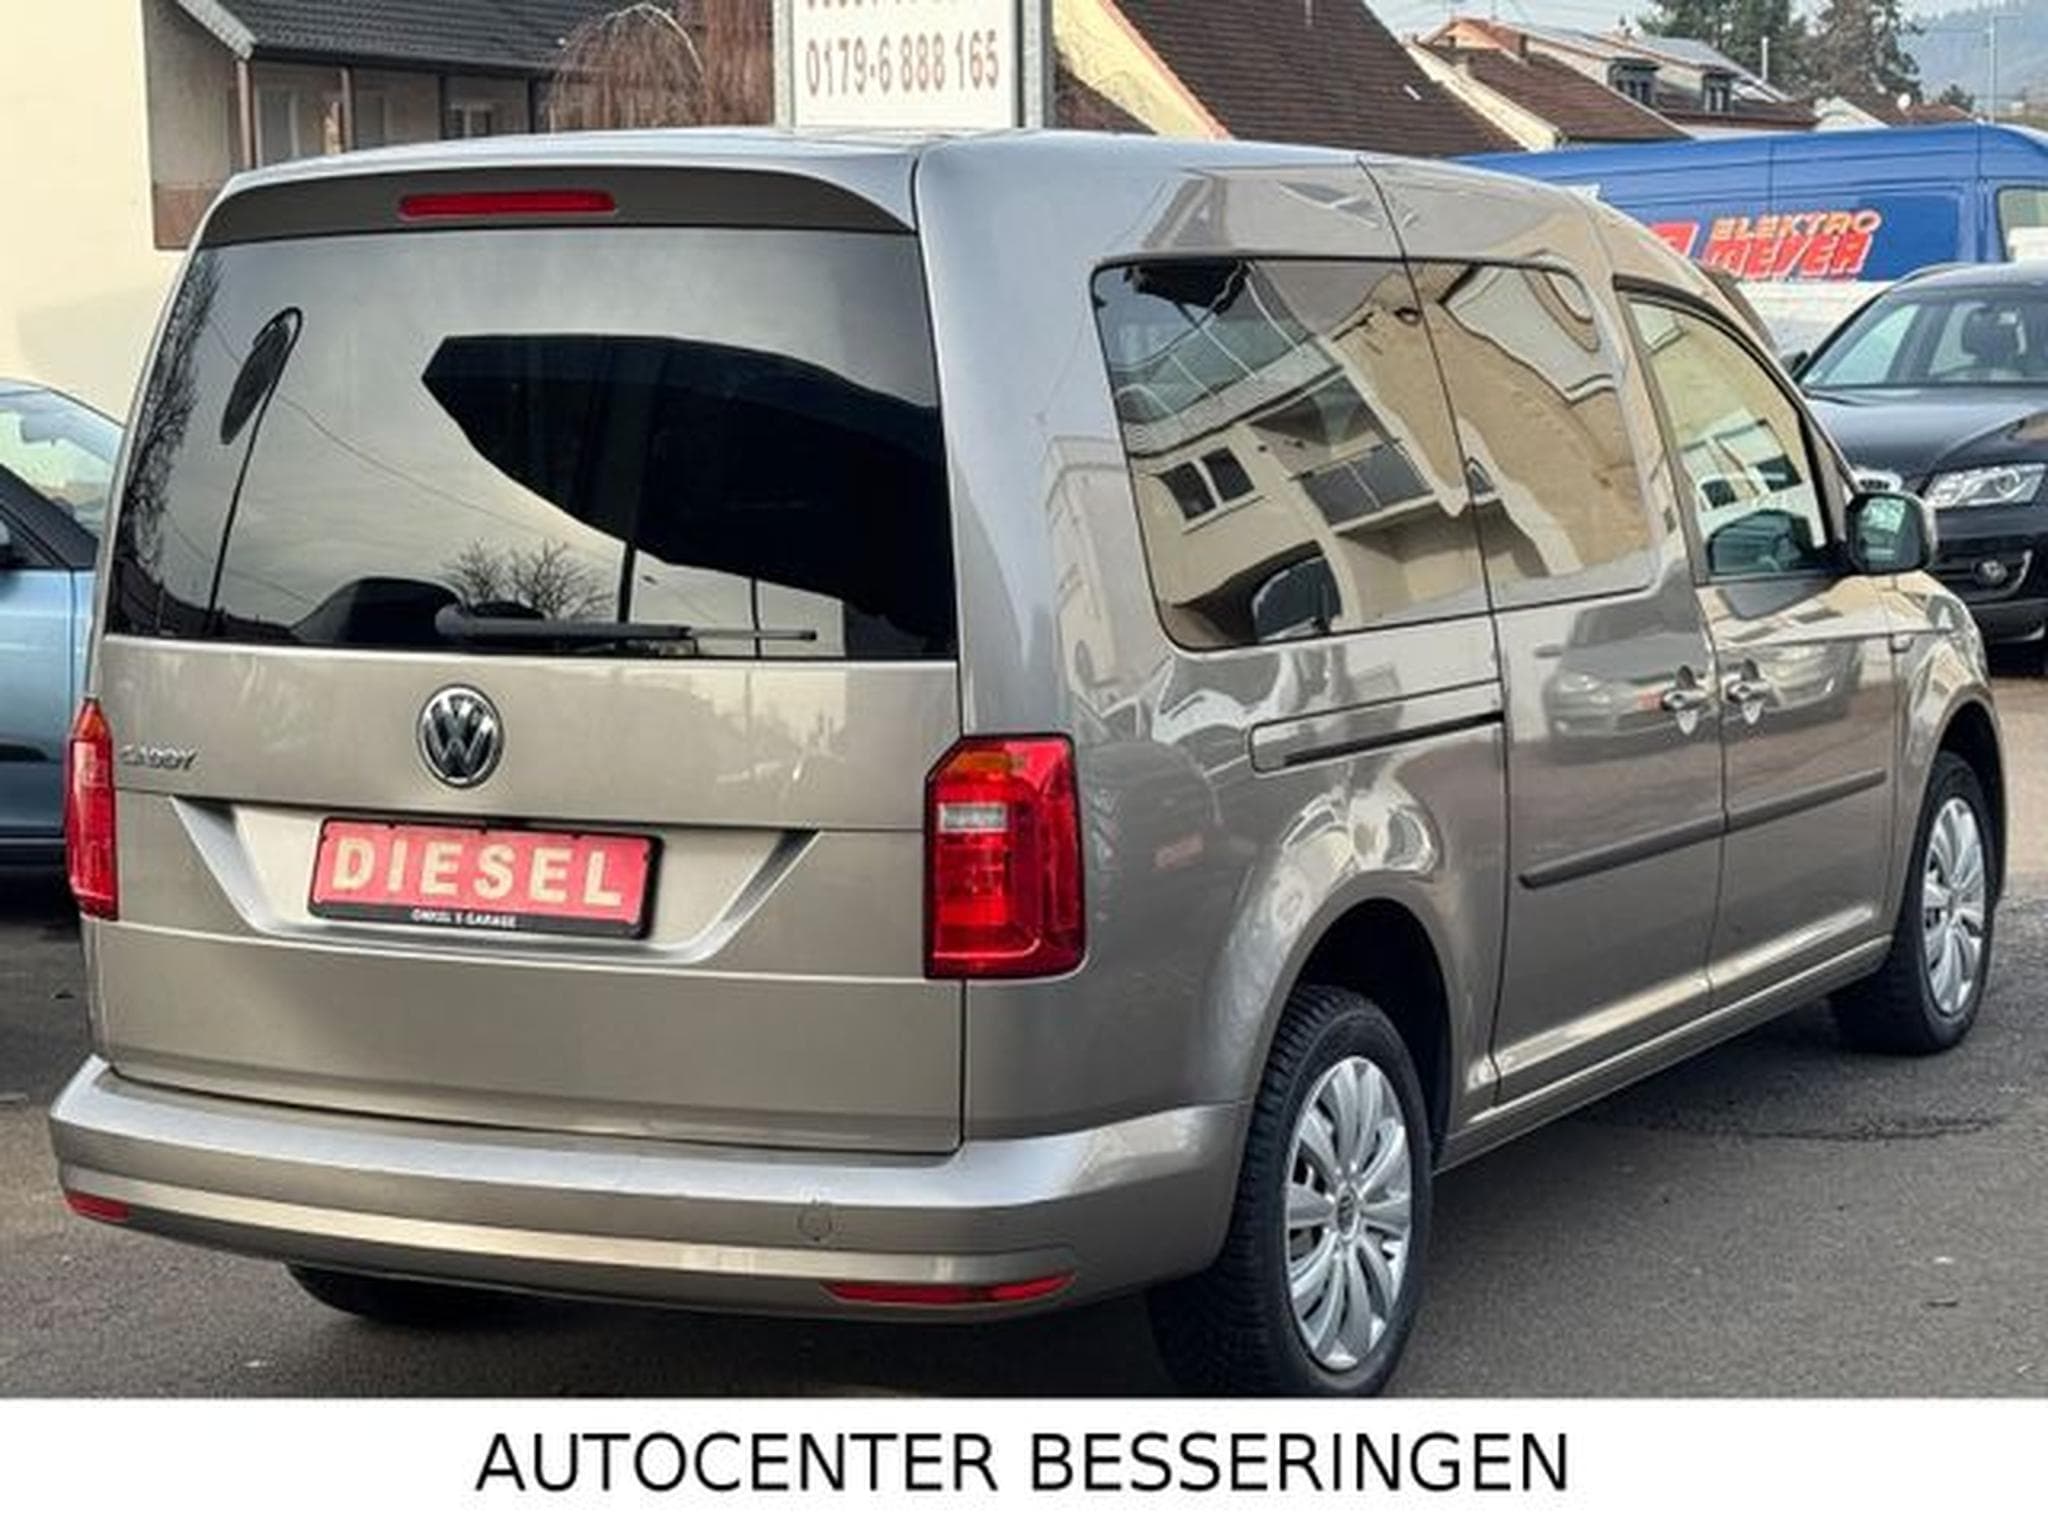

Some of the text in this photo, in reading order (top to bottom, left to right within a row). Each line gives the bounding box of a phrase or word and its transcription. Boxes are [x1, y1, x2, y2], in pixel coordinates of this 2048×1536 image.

[955, 29, 999, 90] 165
[1710, 210, 1882, 242] ELEKTRO
[330, 836, 622, 907] DIESEL
